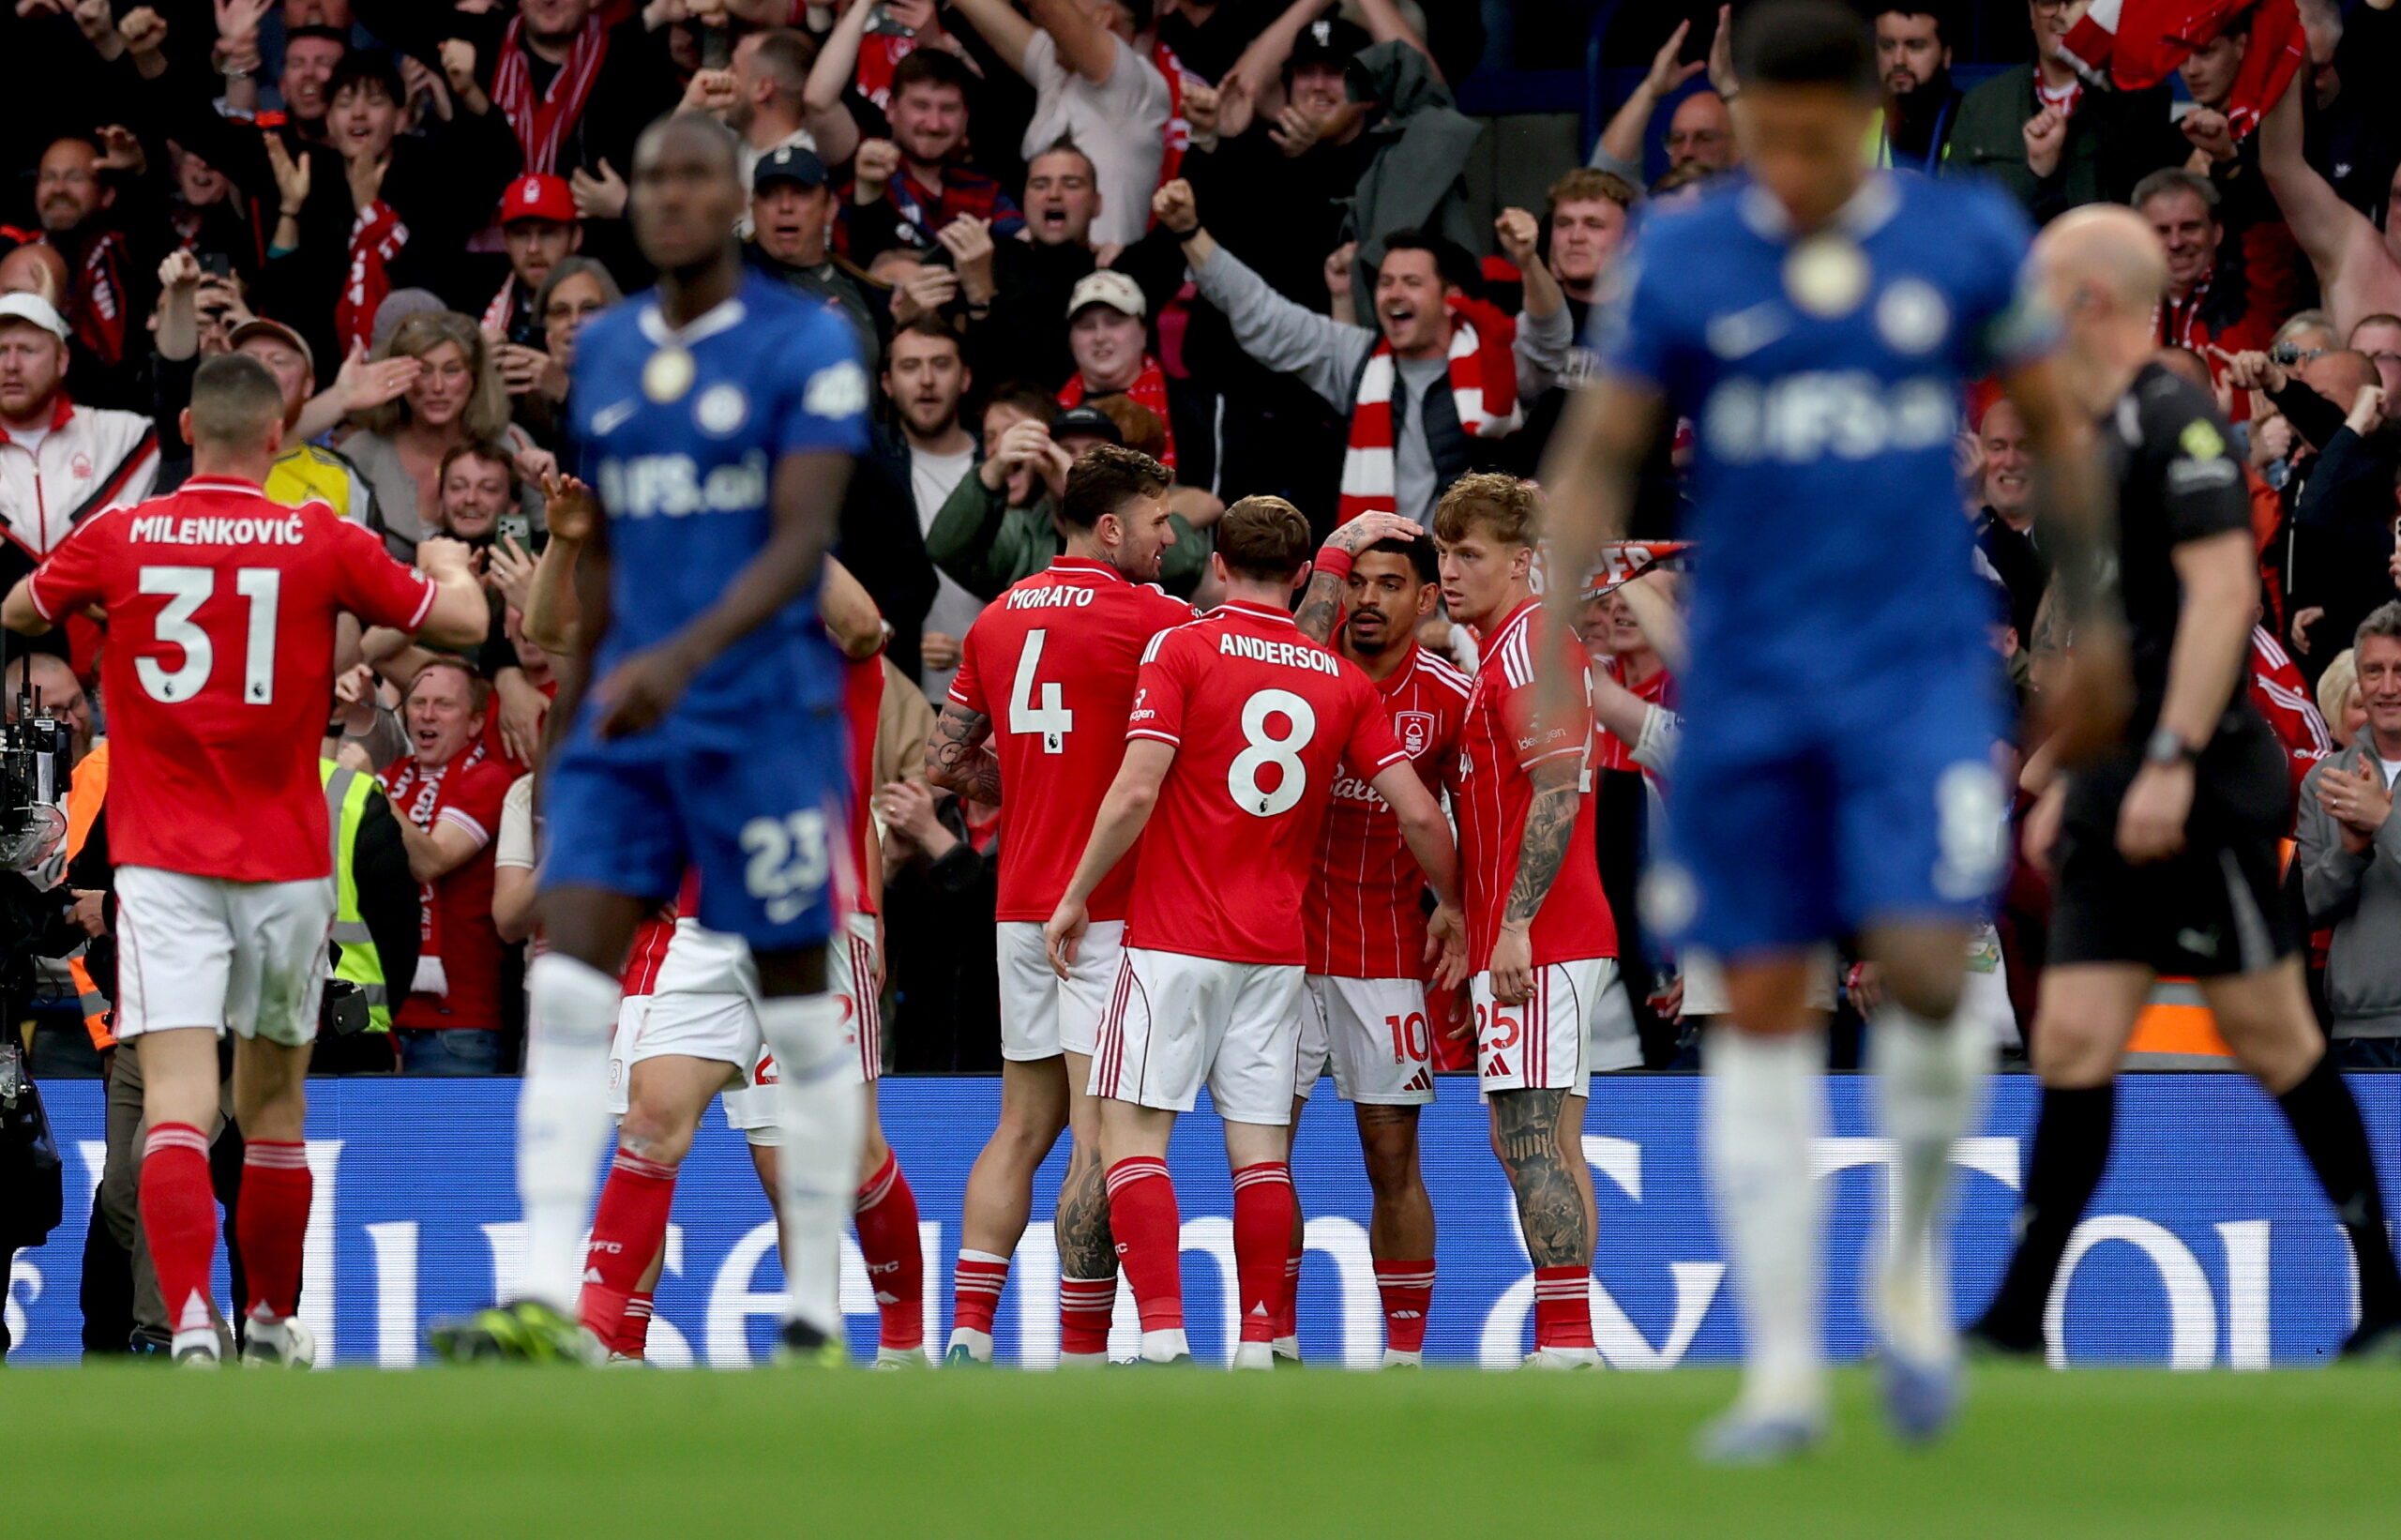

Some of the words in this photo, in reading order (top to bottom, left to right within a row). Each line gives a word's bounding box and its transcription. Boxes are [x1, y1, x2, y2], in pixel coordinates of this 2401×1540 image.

[129, 513, 304, 546] MILENKOVIĆ
[1006, 585, 1095, 610] MORATO
[134, 565, 280, 705] 31
[1219, 633, 1340, 678] ANDERSON
[1008, 628, 1073, 754] 4
[1227, 688, 1317, 818] 8
[739, 808, 829, 898] 23
[1385, 1011, 1430, 1064] 10
[1475, 1000, 1520, 1054] 25
